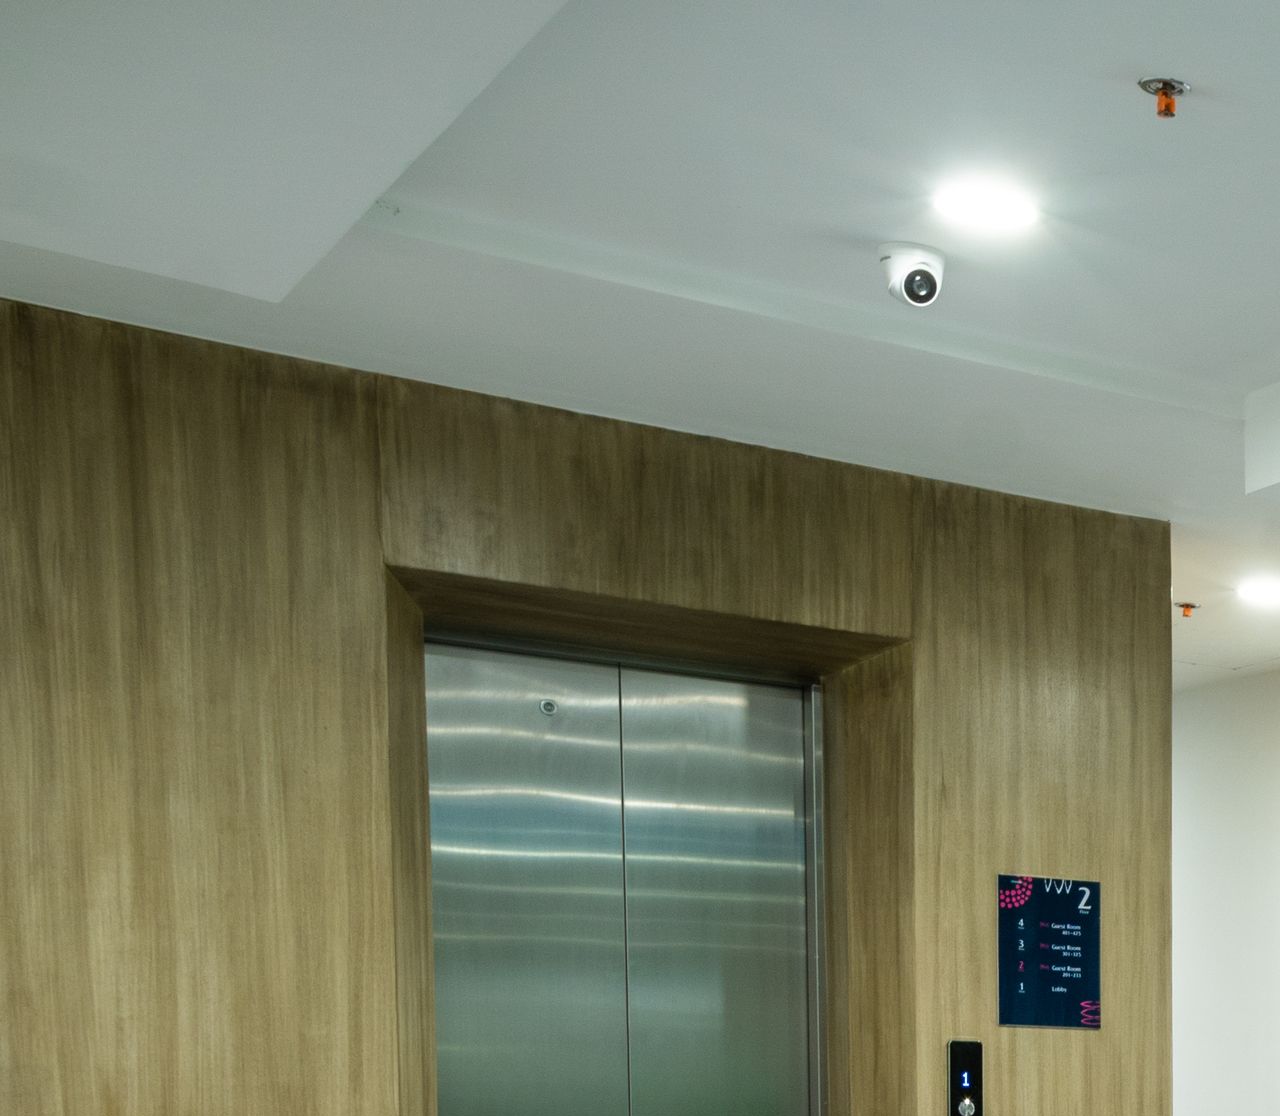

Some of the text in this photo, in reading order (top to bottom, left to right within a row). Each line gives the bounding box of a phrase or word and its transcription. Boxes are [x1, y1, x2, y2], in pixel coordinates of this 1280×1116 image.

[1078, 886, 1092, 910] 2
[1018, 918, 1024, 927] 4
[1018, 939, 1024, 948] 3
[962, 1071, 970, 1087] 1
